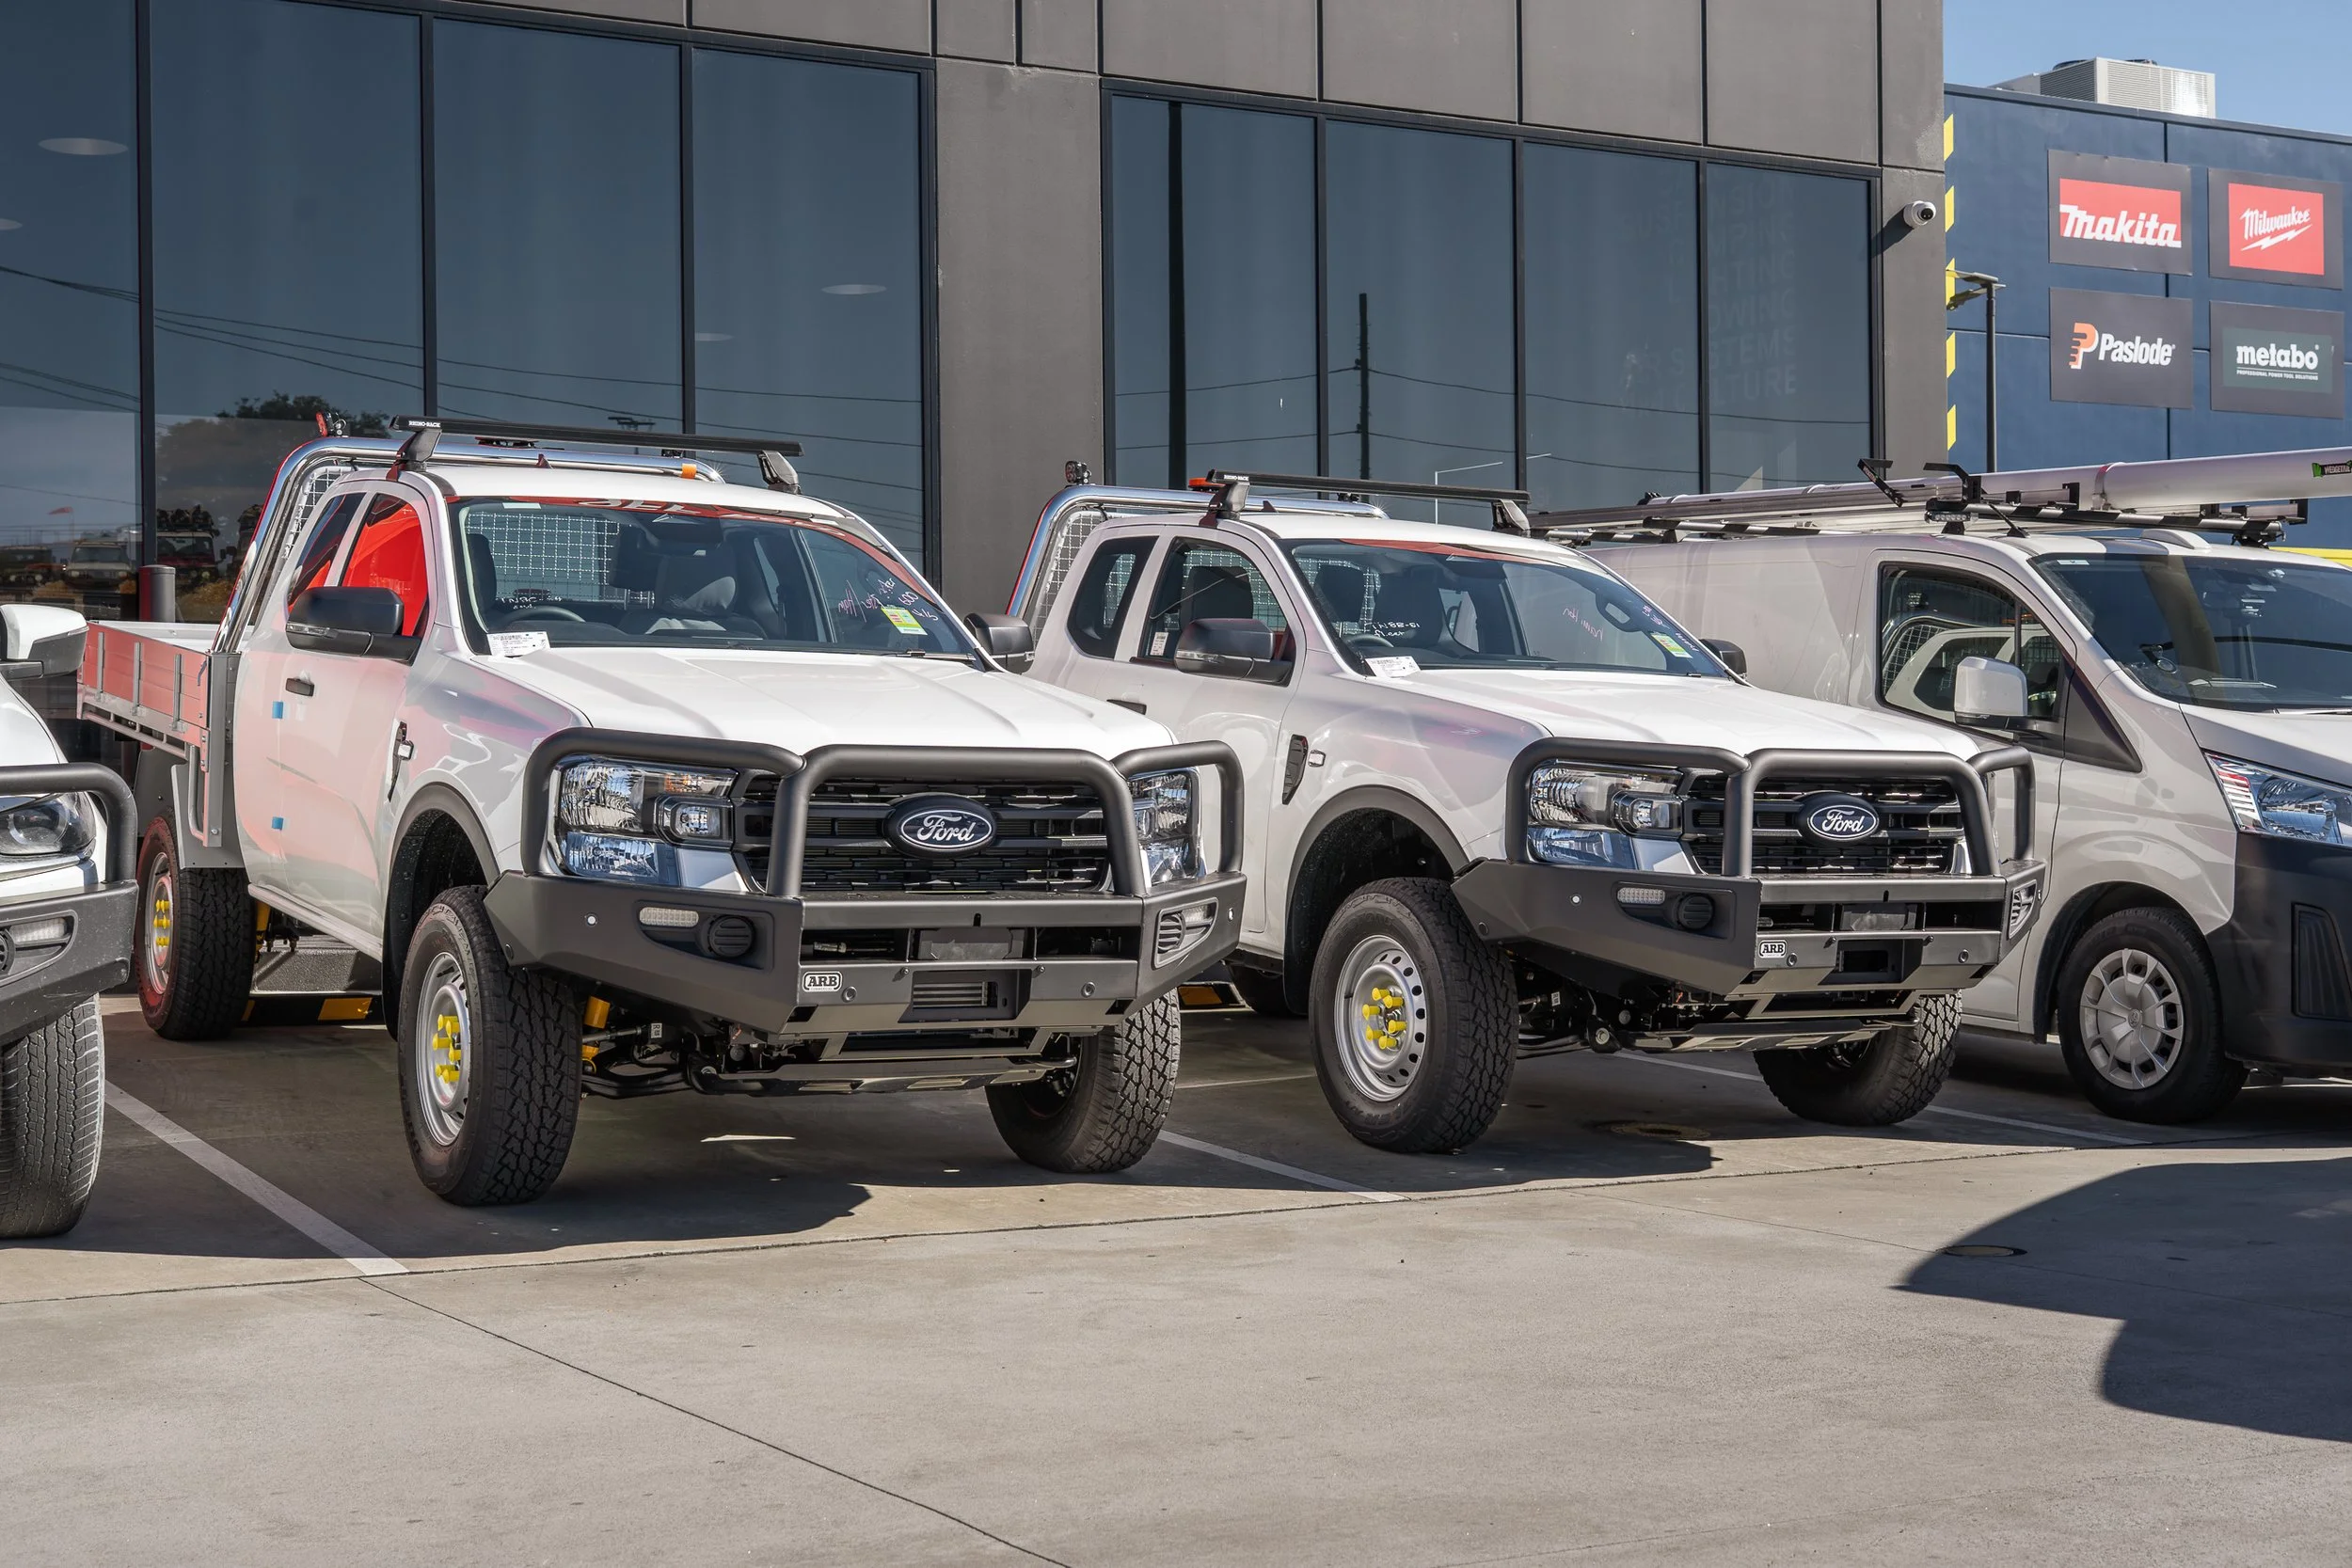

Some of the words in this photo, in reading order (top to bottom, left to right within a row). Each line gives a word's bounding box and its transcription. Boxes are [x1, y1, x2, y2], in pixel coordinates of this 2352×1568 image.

[2240, 206, 2311, 240] Milwaukee
[2098, 333, 2172, 366] Paslode
[2236, 343, 2318, 370] metabo
[916, 815, 975, 842] Ford
[1821, 809, 1865, 832] Ford
[1762, 943, 1784, 954] ARB
[807, 975, 837, 987] ARB
